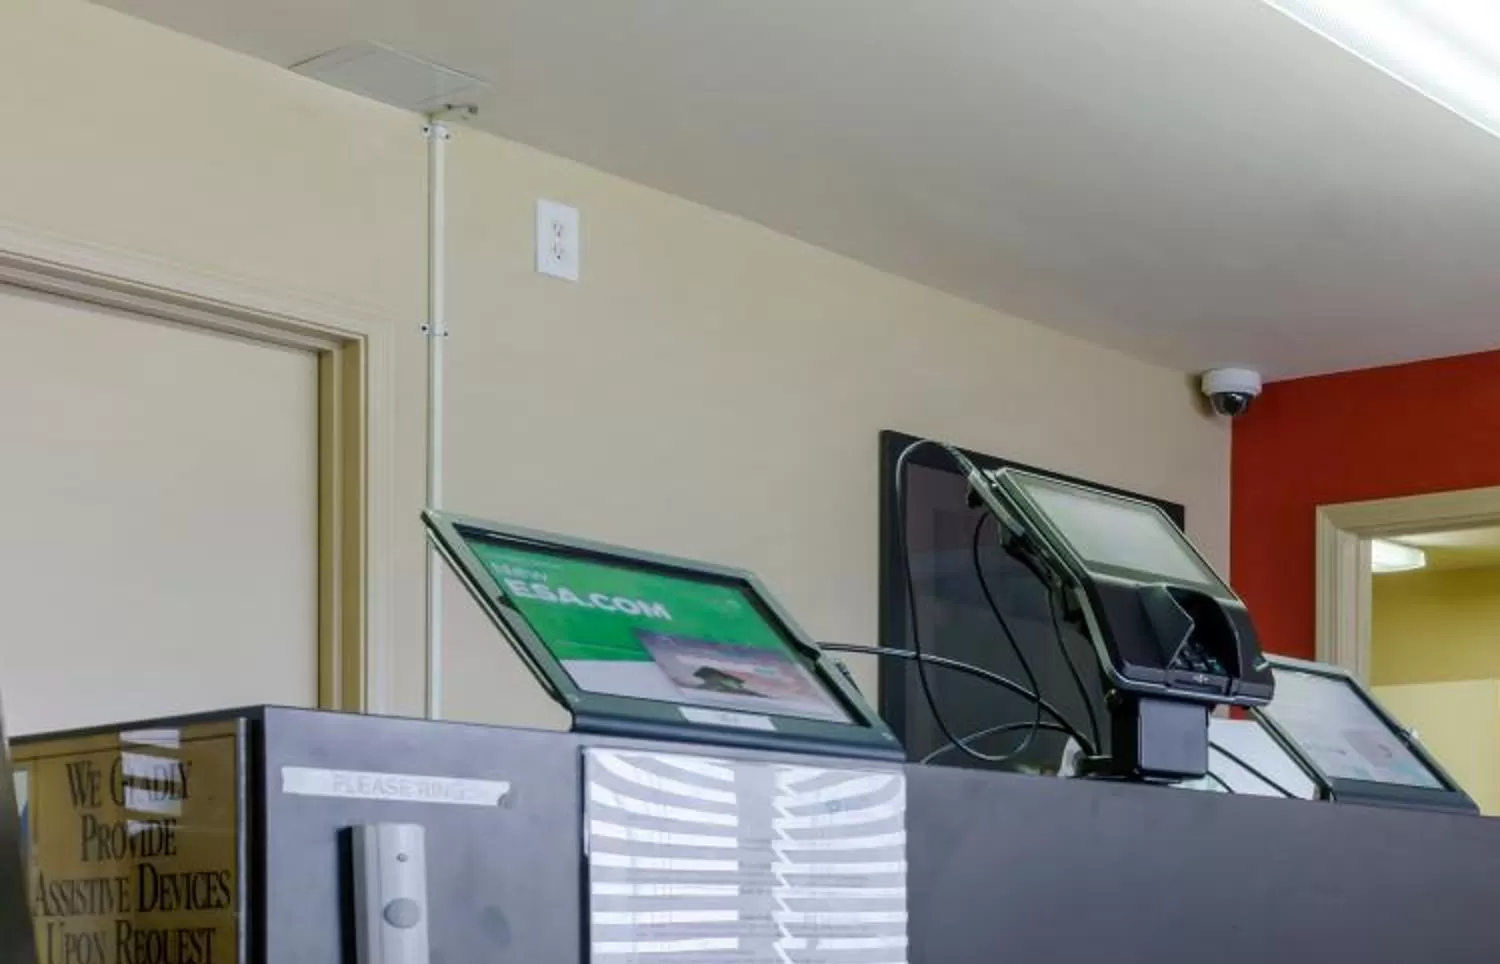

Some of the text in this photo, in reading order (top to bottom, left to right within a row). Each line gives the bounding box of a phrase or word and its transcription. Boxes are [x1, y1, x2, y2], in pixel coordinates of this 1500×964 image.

[504, 578, 673, 621] ESA.COM
[80, 814, 177, 863] PROVIDE
[35, 869, 131, 918] ASSISTIVE
[137, 862, 231, 914] DEVICES
